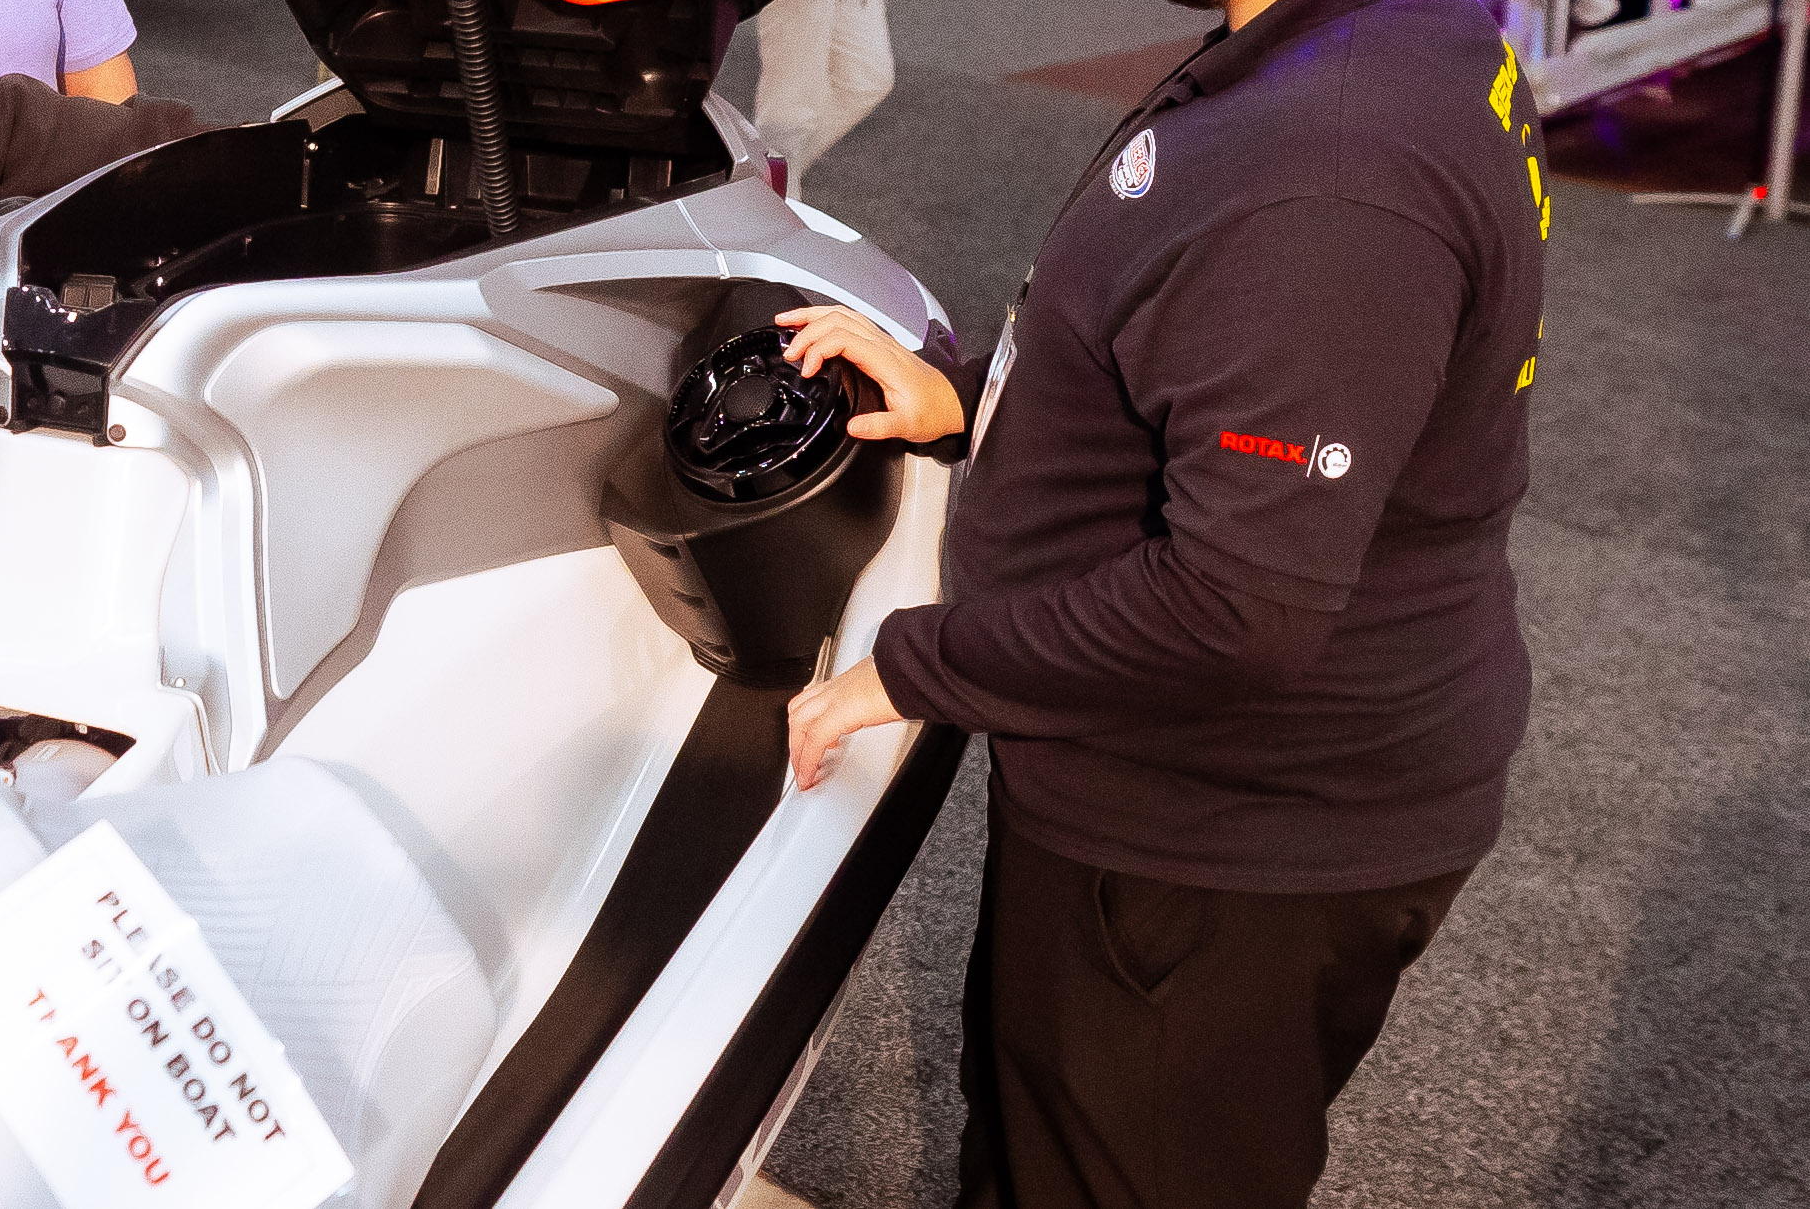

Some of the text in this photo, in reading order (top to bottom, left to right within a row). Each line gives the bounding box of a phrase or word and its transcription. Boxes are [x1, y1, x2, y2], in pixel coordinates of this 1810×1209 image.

[1220, 430, 1308, 465] ROTAX
[127, 998, 171, 1048] ON
[164, 1053, 237, 1142] BOAT
[191, 1016, 231, 1066] DO
[229, 1072, 287, 1142] NOT
[115, 1109, 171, 1186] YOU
